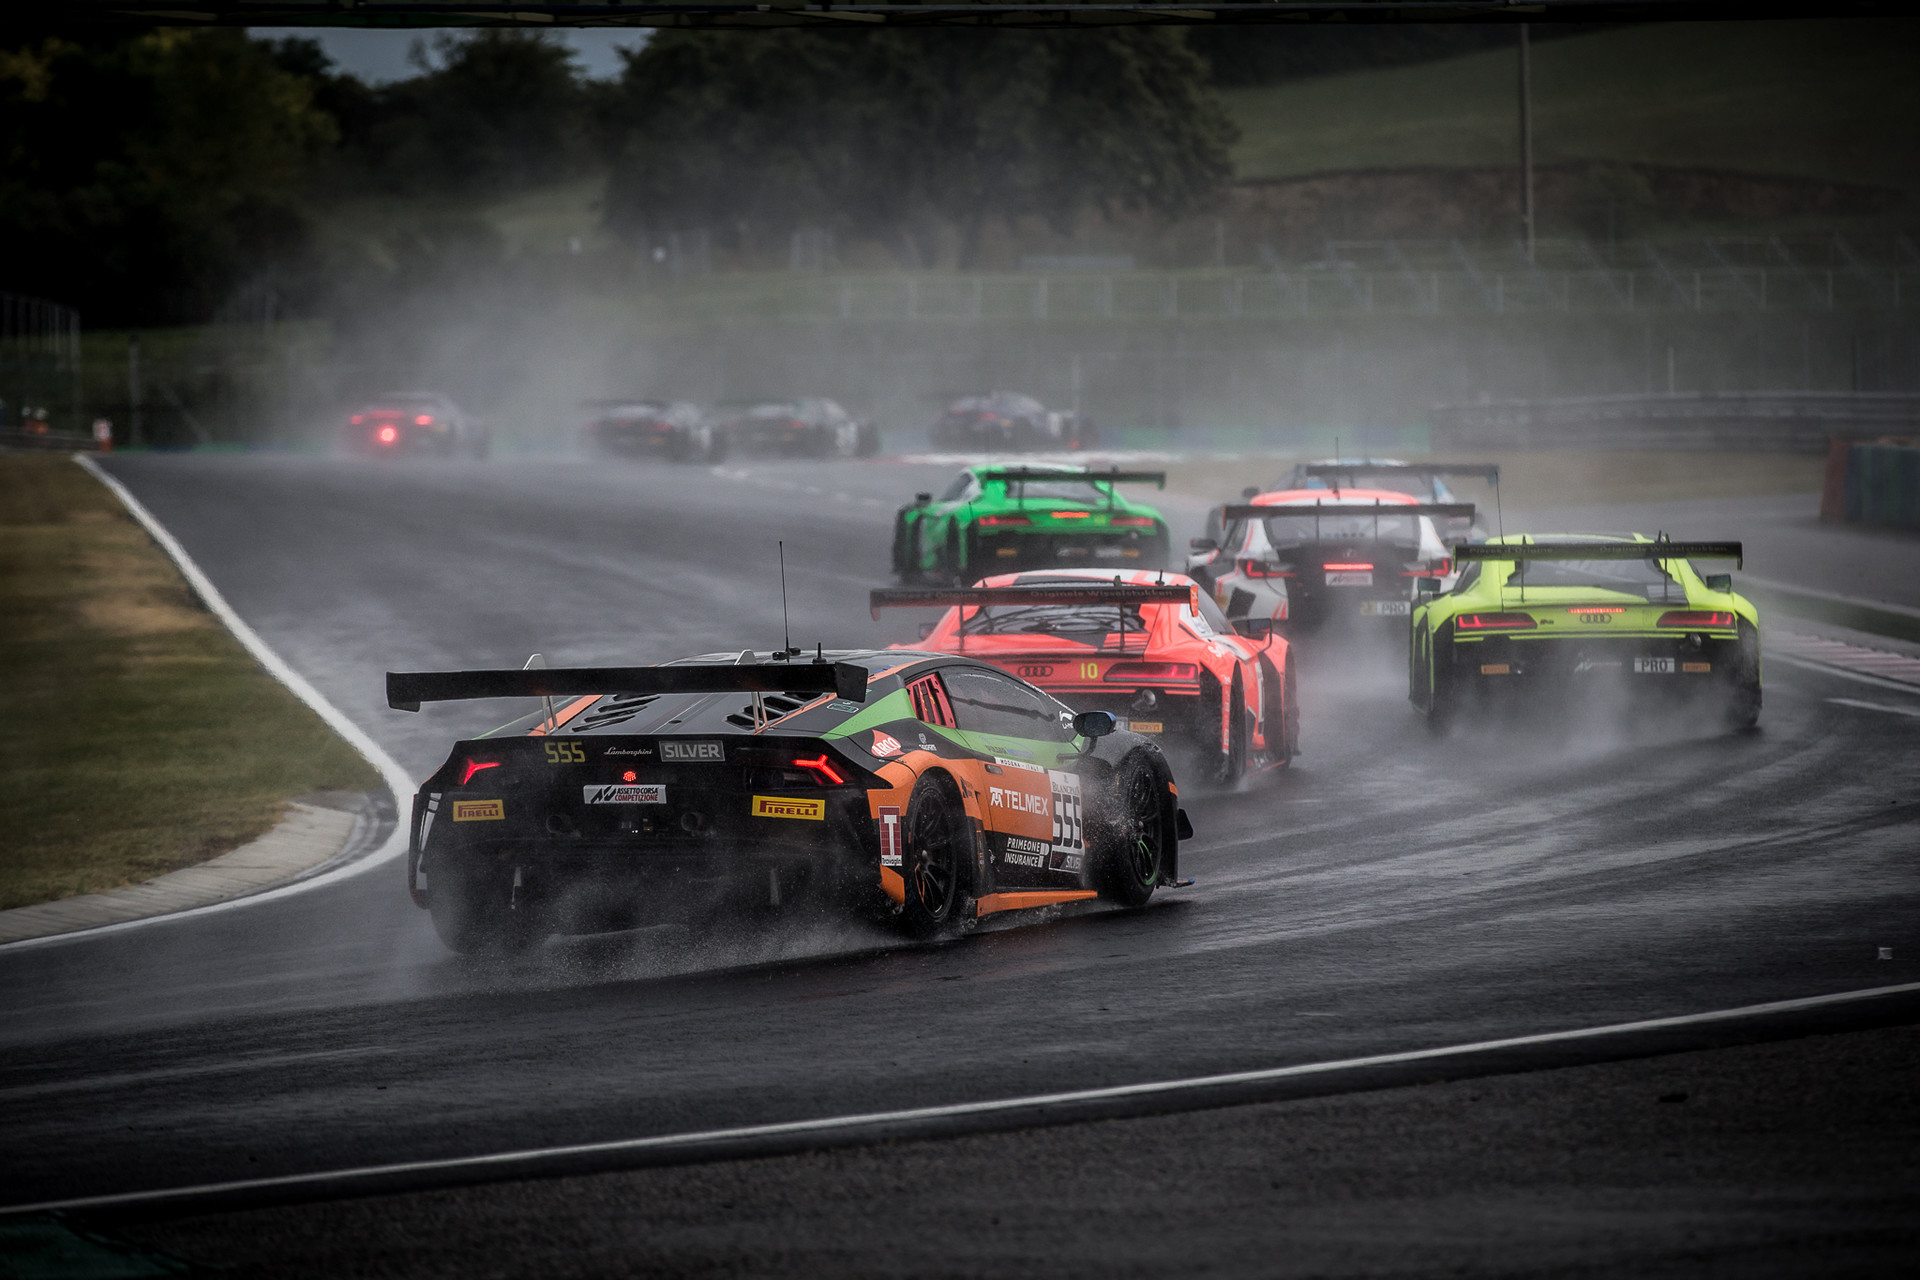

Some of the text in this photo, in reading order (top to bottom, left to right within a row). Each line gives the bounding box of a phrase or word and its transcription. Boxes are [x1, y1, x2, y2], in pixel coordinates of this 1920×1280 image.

[1081, 662, 1098, 679] 10
[1641, 659, 1669, 672] PRO
[544, 741, 586, 763] 555
[604, 746, 653, 757] Lamborghini
[664, 744, 721, 759] SILVER
[871, 737, 901, 757] ARCO
[615, 794, 658, 802] COMPETIZIONE
[1004, 789, 1049, 817] TELMEX
[457, 803, 499, 818] PIRELLI
[759, 800, 819, 816] PIRELLI
[1052, 792, 1082, 850] 555
[1006, 837, 1040, 852] PRIMEONE
[1004, 852, 1040, 868] INSURANCE
